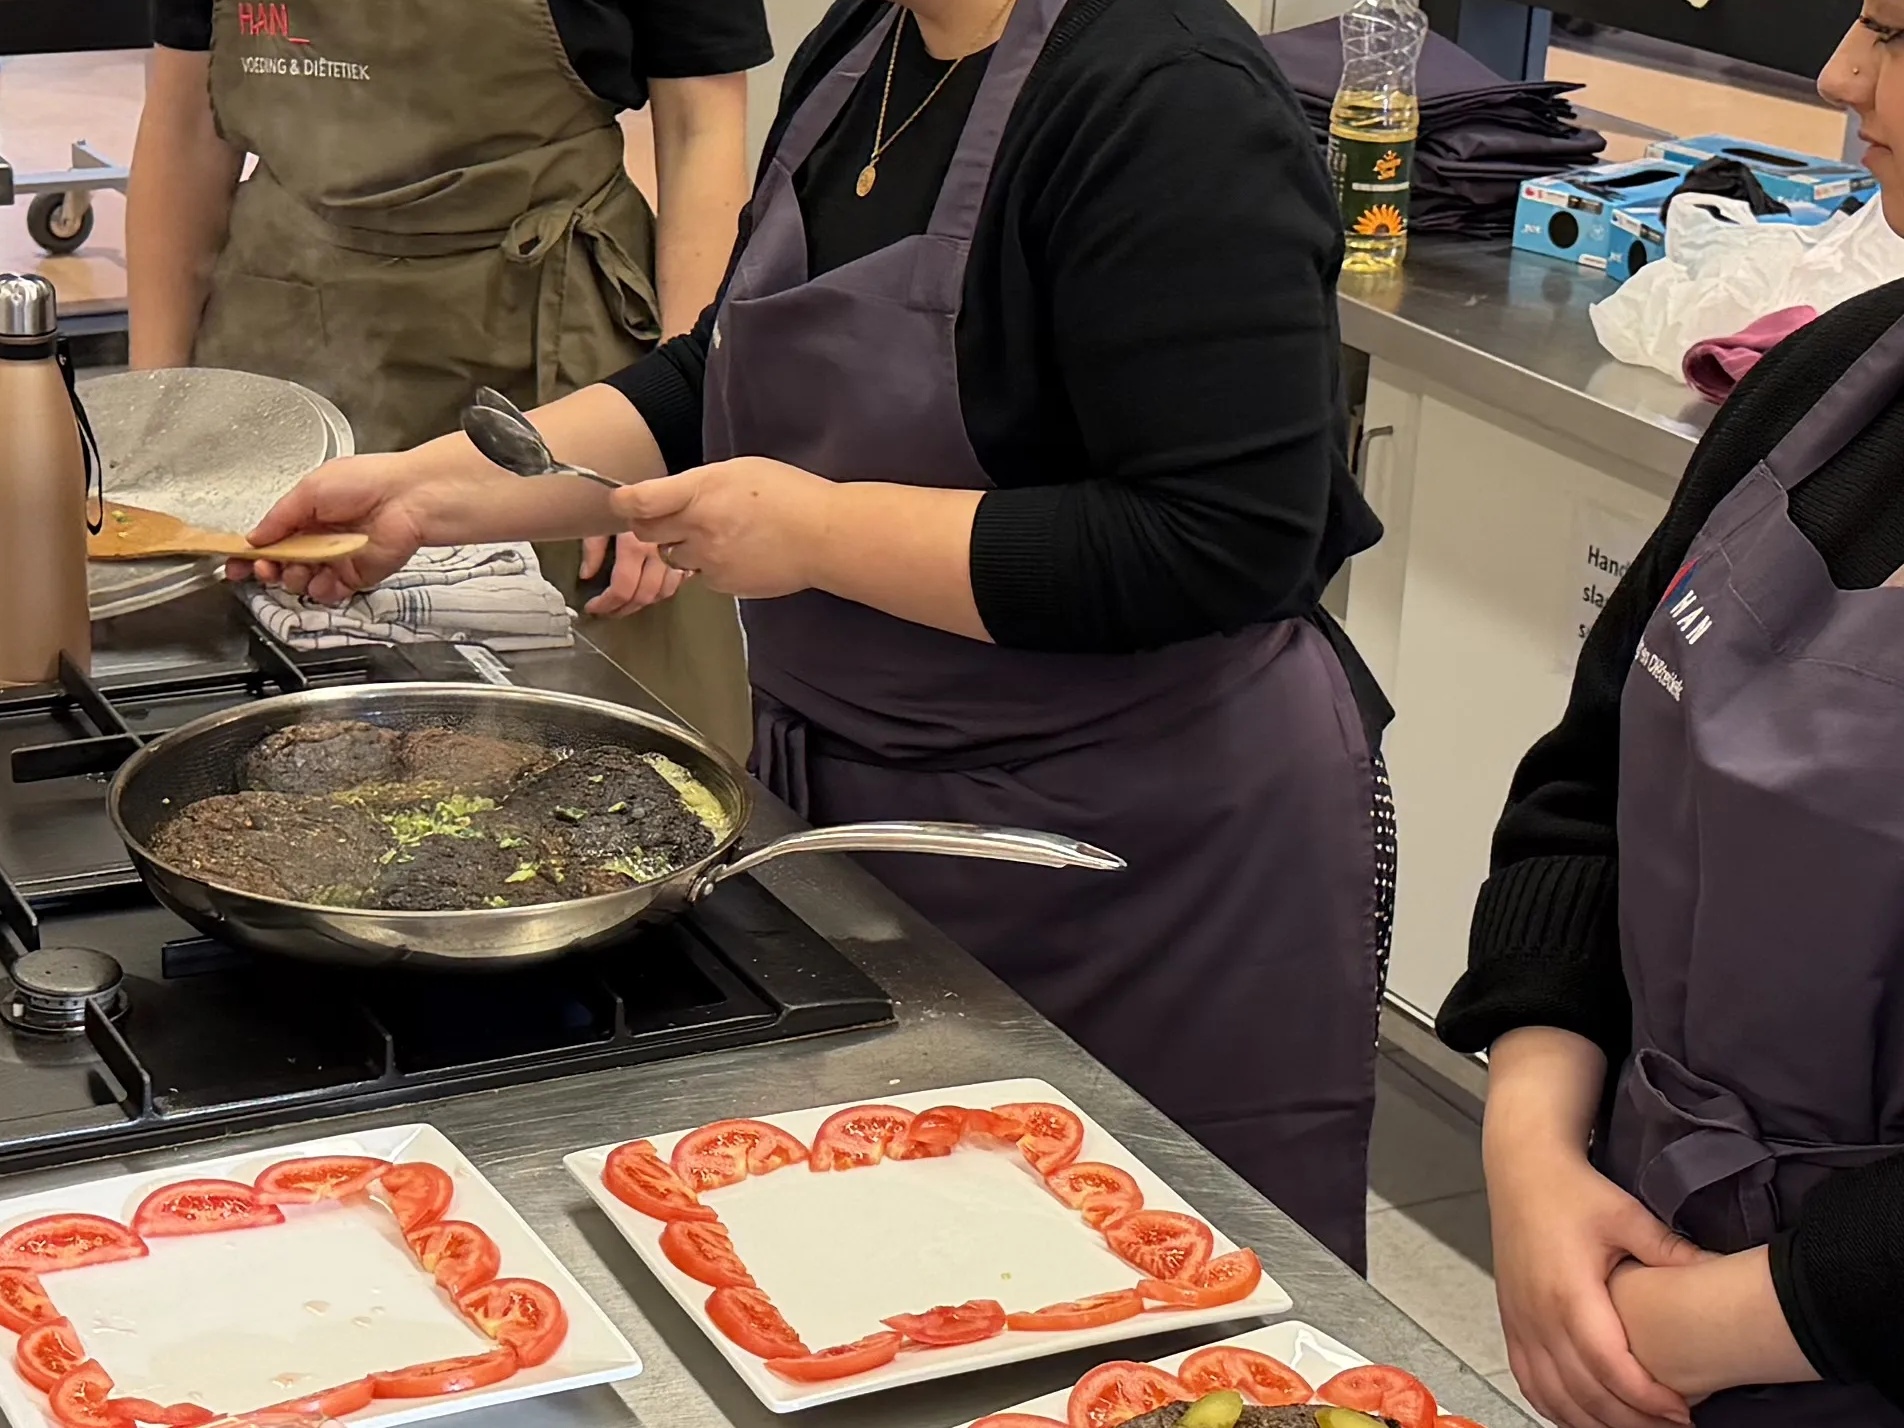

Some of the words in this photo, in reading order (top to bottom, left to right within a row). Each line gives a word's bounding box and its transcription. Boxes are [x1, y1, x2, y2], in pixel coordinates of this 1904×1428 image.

[240, 57, 286, 75] VOEDING
[289, 58, 301, 75] &
[1670, 590, 1713, 645] HAN
